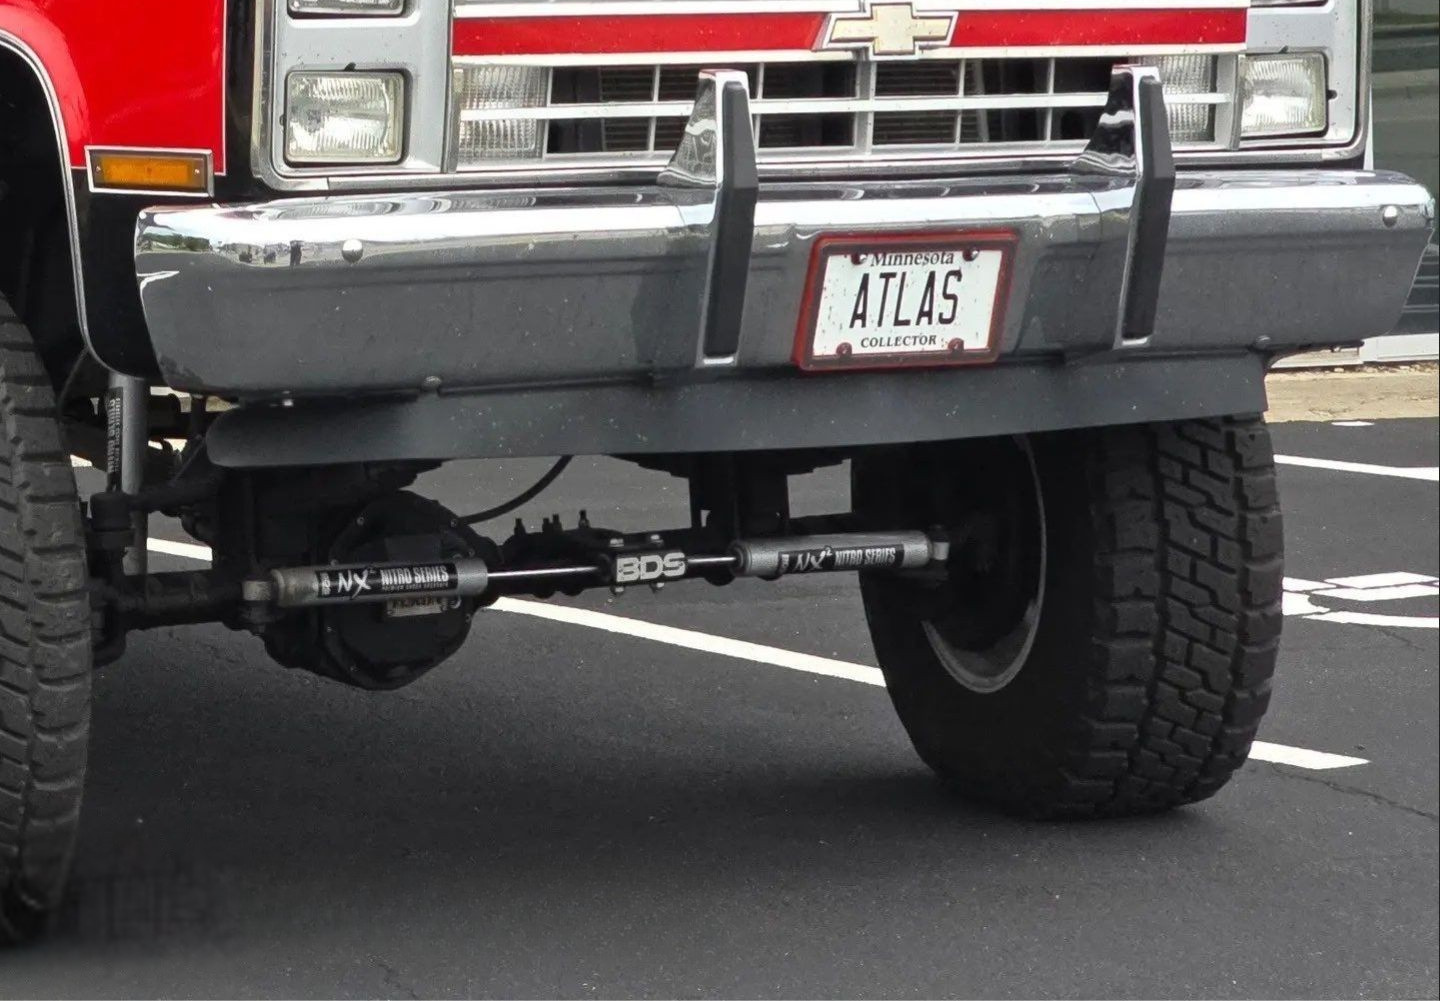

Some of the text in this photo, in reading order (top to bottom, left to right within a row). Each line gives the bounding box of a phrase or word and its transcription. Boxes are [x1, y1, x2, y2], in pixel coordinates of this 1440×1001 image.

[870, 251, 954, 267] Minnesota
[849, 269, 963, 328] ATLAS
[860, 334, 937, 349] COLLECTOR
[616, 552, 686, 582] BDS
[835, 549, 863, 567] NITRO
[864, 547, 896, 566] SERIES
[380, 567, 411, 585] NITRO
[413, 565, 449, 584] SERIES
